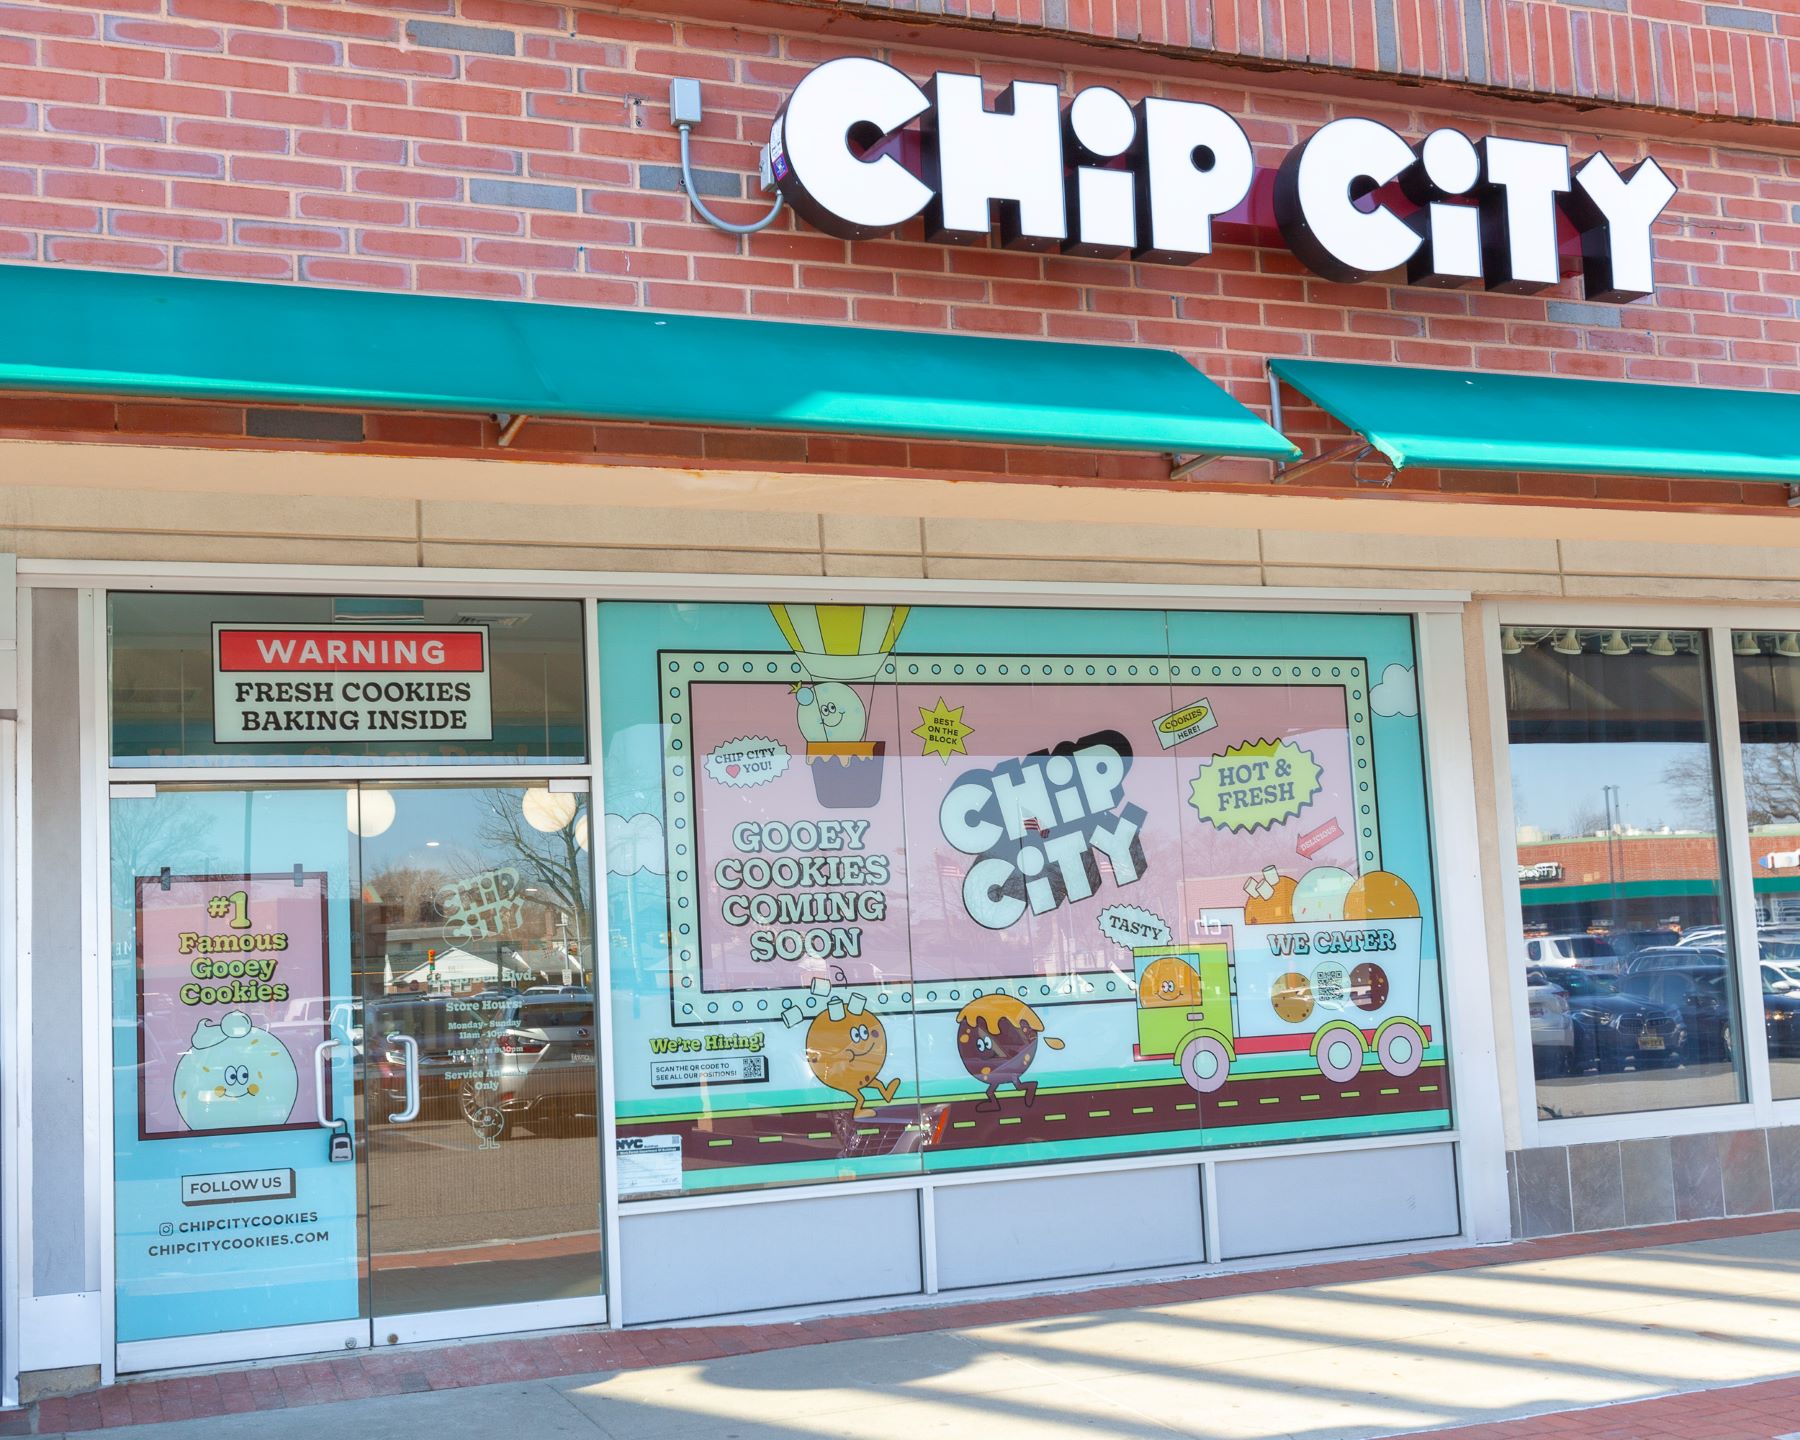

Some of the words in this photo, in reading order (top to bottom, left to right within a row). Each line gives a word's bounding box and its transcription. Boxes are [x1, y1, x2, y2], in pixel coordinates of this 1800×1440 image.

[256, 639, 446, 665] WARNING
[235, 682, 334, 702] FRESH
[342, 682, 471, 702] COOKIES
[241, 710, 359, 731] BAKING
[367, 710, 468, 730] INSIDE
[933, 717, 955, 727] BEST
[1164, 708, 1203, 730] COOKIES
[927, 725, 940, 734] ON
[942, 727, 959, 737] THE
[929, 734, 957, 745] BLOCK
[1177, 724, 1201, 740] HERE!
[714, 751, 744, 765] CHIP
[747, 747, 776, 761] CITY
[743, 761, 773, 774] YOU!
[1218, 761, 1270, 787] HOT
[1274, 758, 1292, 778] &
[1217, 781, 1295, 812] FRESH
[732, 820, 870, 853] GOOEY
[714, 855, 889, 890] COOKIES
[207, 890, 252, 929] #1
[722, 891, 887, 926] COMING
[1109, 915, 1163, 941] TASTY
[178, 932, 288, 954] Famous
[750, 928, 862, 961] SOON
[1267, 932, 1311, 956] WE
[1312, 929, 1397, 954] CATER
[191, 957, 278, 981] Gooey
[502, 967, 537, 981] Blvd.
[179, 980, 289, 1006] Cookies
[446, 1001, 480, 1012] Store
[482, 999, 523, 1010] Hours:
[448, 1022, 483, 1030] Monday
[489, 1020, 521, 1028] Sunday
[704, 1032, 765, 1052] Hiring!
[445, 1070, 484, 1080] Service
[690, 1064, 700, 1072] QR
[701, 1063, 720, 1071] CODE
[475, 1081, 499, 1091] Only
[616, 1139, 643, 1150] NYC
[190, 1179, 258, 1194] FOLLOW
[262, 1176, 282, 1189] US
[178, 1211, 318, 1233] CHIPCITYCOOKIES
[148, 1231, 330, 1257] CHIPCITYCOOKIES.COM
